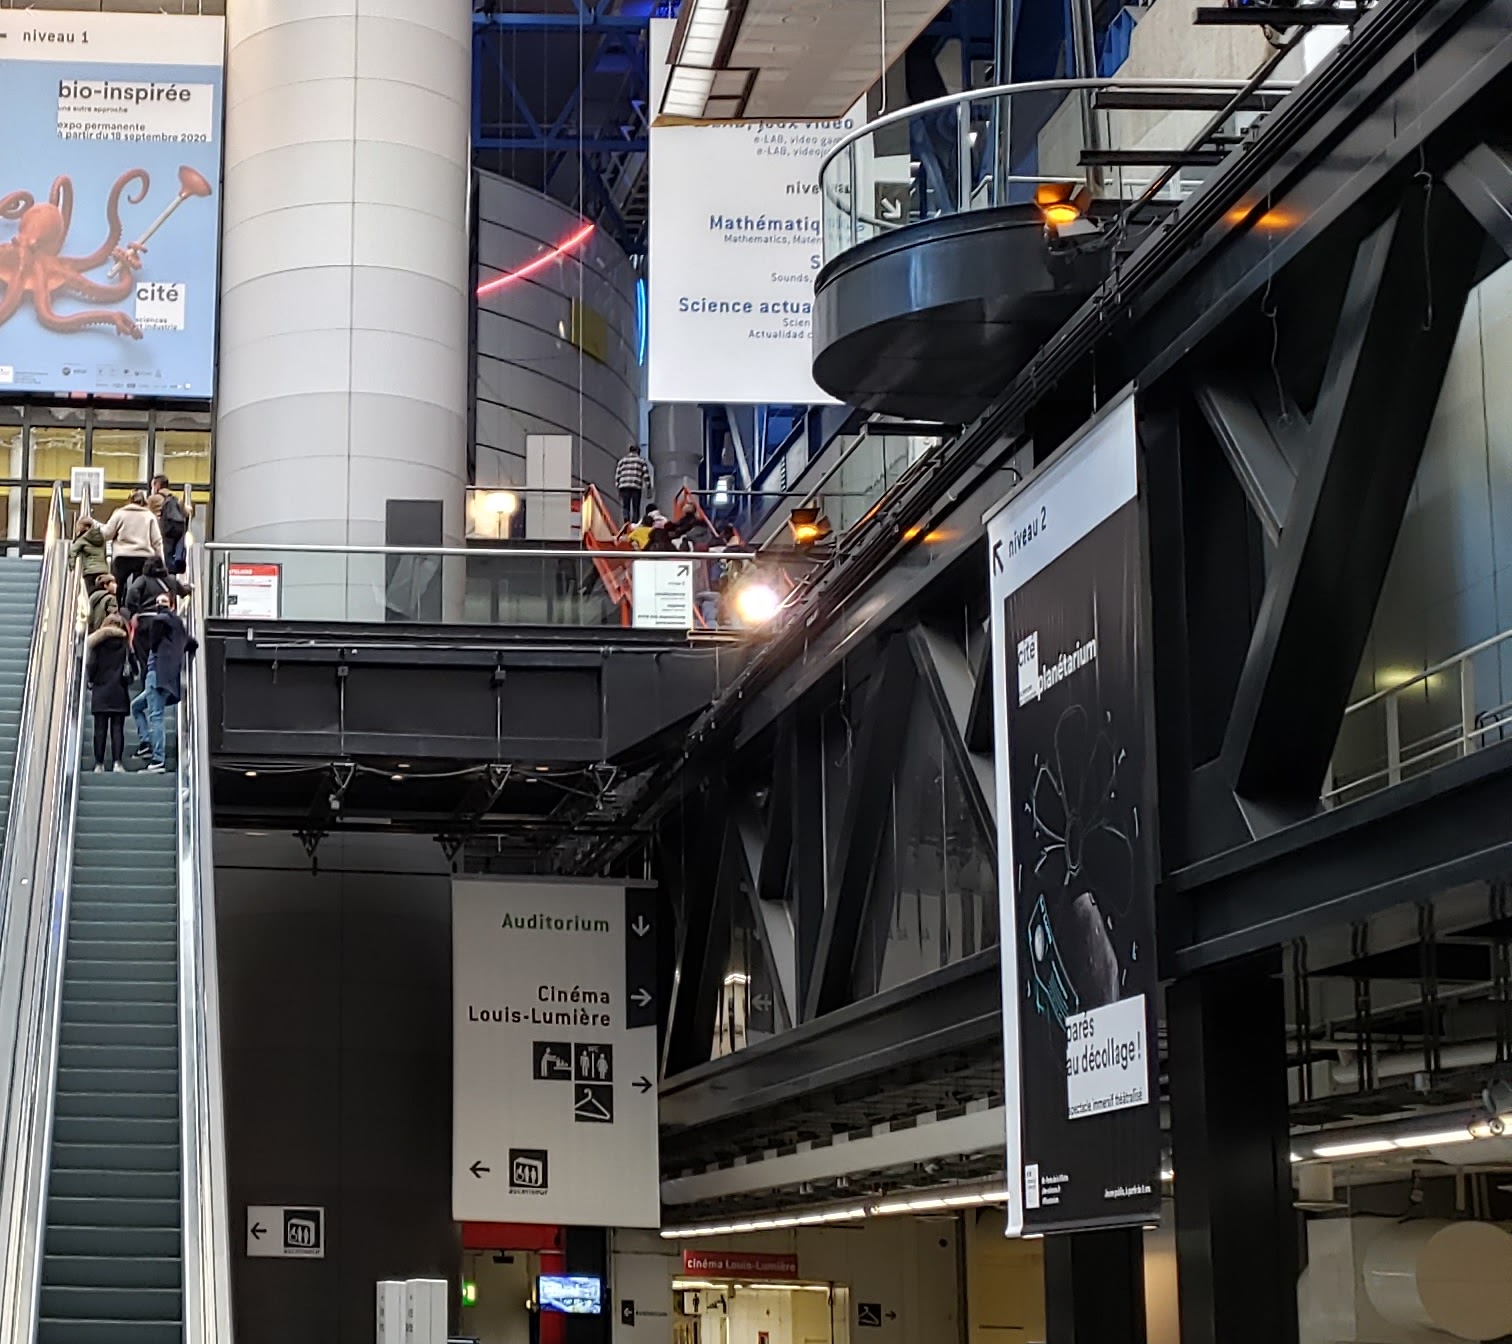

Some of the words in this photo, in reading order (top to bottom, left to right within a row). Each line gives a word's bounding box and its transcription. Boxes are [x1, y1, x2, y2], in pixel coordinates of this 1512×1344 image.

[23, 29, 75, 44] niveau
[82, 31, 88, 44] 1
[59, 79, 191, 105] bio-inspirée
[57, 122, 82, 132] expo
[84, 121, 146, 132] permanente
[65, 131, 93, 141] partir
[96, 131, 109, 140] du
[124, 132, 178, 143] septembre
[181, 134, 207, 143] 2020
[136, 282, 178, 302] cité
[679, 297, 753, 313] Science
[748, 330, 804, 339] Actualidad
[1008, 518, 1038, 558] niveau
[1040, 506, 1047, 532] 2
[1038, 639, 1097, 701] planétarium
[501, 913, 609, 933] Auditorium
[538, 985, 610, 1004] Cinéma
[468, 1005, 611, 1027] Louis-Lumière
[1067, 1011, 1094, 1043] parés
[1066, 1055, 1079, 1077] au
[1081, 1037, 1135, 1071] décollage
[1137, 1031, 1141, 1059] !
[687, 1258, 723, 1269] cinéma
[726, 1259, 796, 1272] Louis-Lumière
